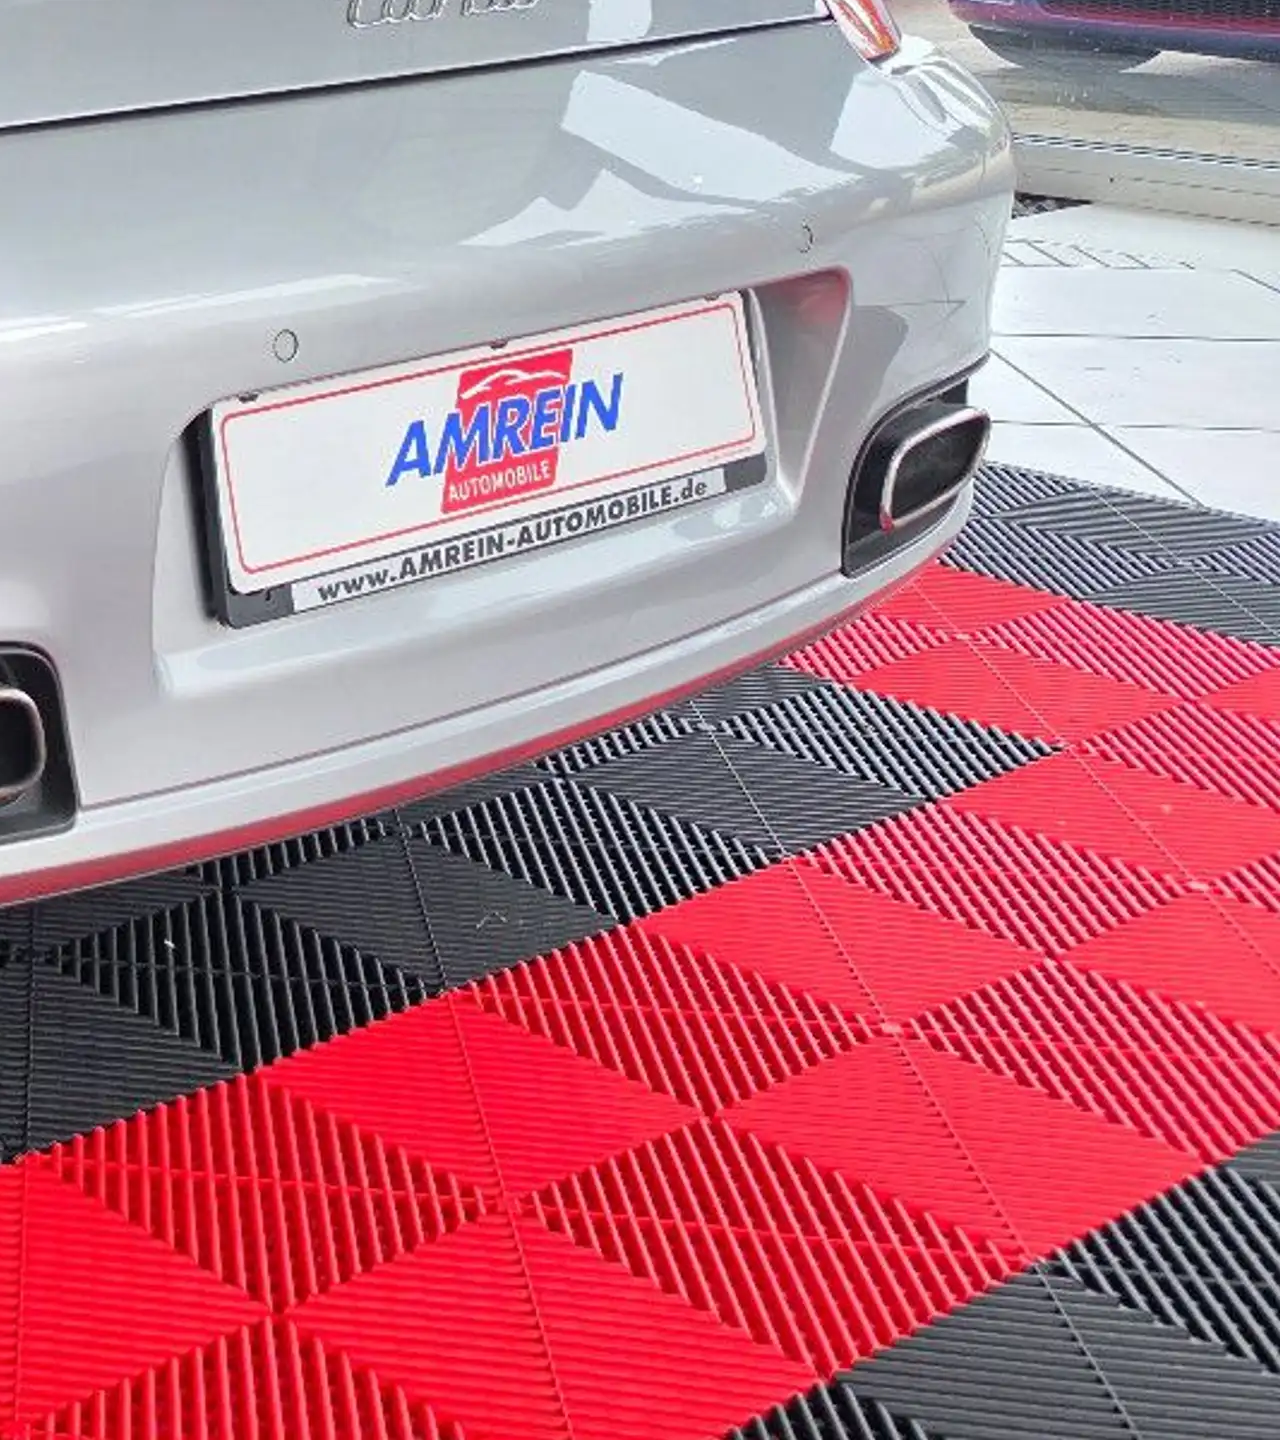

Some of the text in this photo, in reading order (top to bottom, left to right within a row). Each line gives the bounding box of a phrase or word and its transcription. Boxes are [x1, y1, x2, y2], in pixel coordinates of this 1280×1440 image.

[384, 372, 624, 488] AMREIN
[448, 459, 552, 502] AUTOMOBILE
[317, 478, 708, 602] www.AMREIN-AUTOMOBILE.de
